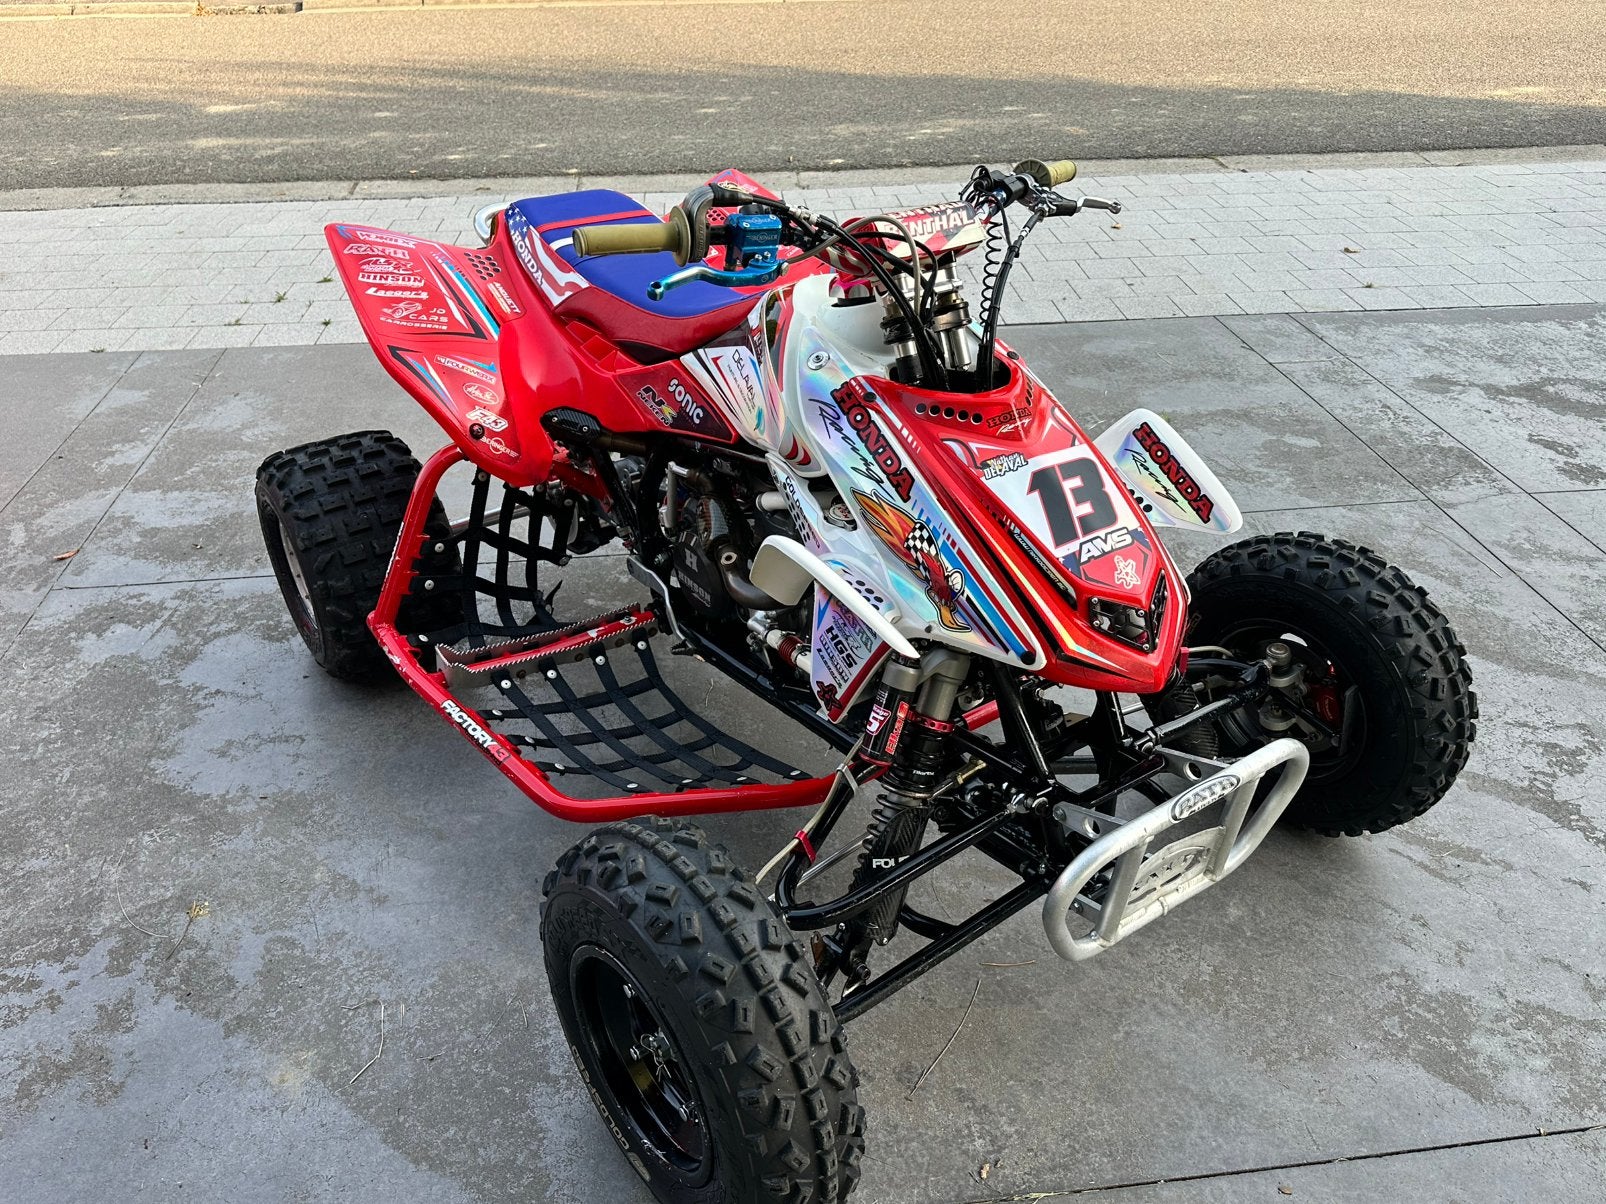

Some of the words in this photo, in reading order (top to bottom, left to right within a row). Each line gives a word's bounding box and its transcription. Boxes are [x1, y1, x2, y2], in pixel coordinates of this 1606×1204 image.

[359, 272, 425, 286] HINSON
[511, 231, 545, 287] HONDA
[409, 313, 448, 323] CARS
[986, 407, 1032, 428] HONDA
[830, 381, 915, 503] HONDA
[984, 455, 1028, 480] DELAVAL
[1132, 422, 1214, 524] HONDA
[1027, 457, 1118, 549] 13
[1080, 527, 1133, 565] AMS
[826, 625, 857, 669] HGS
